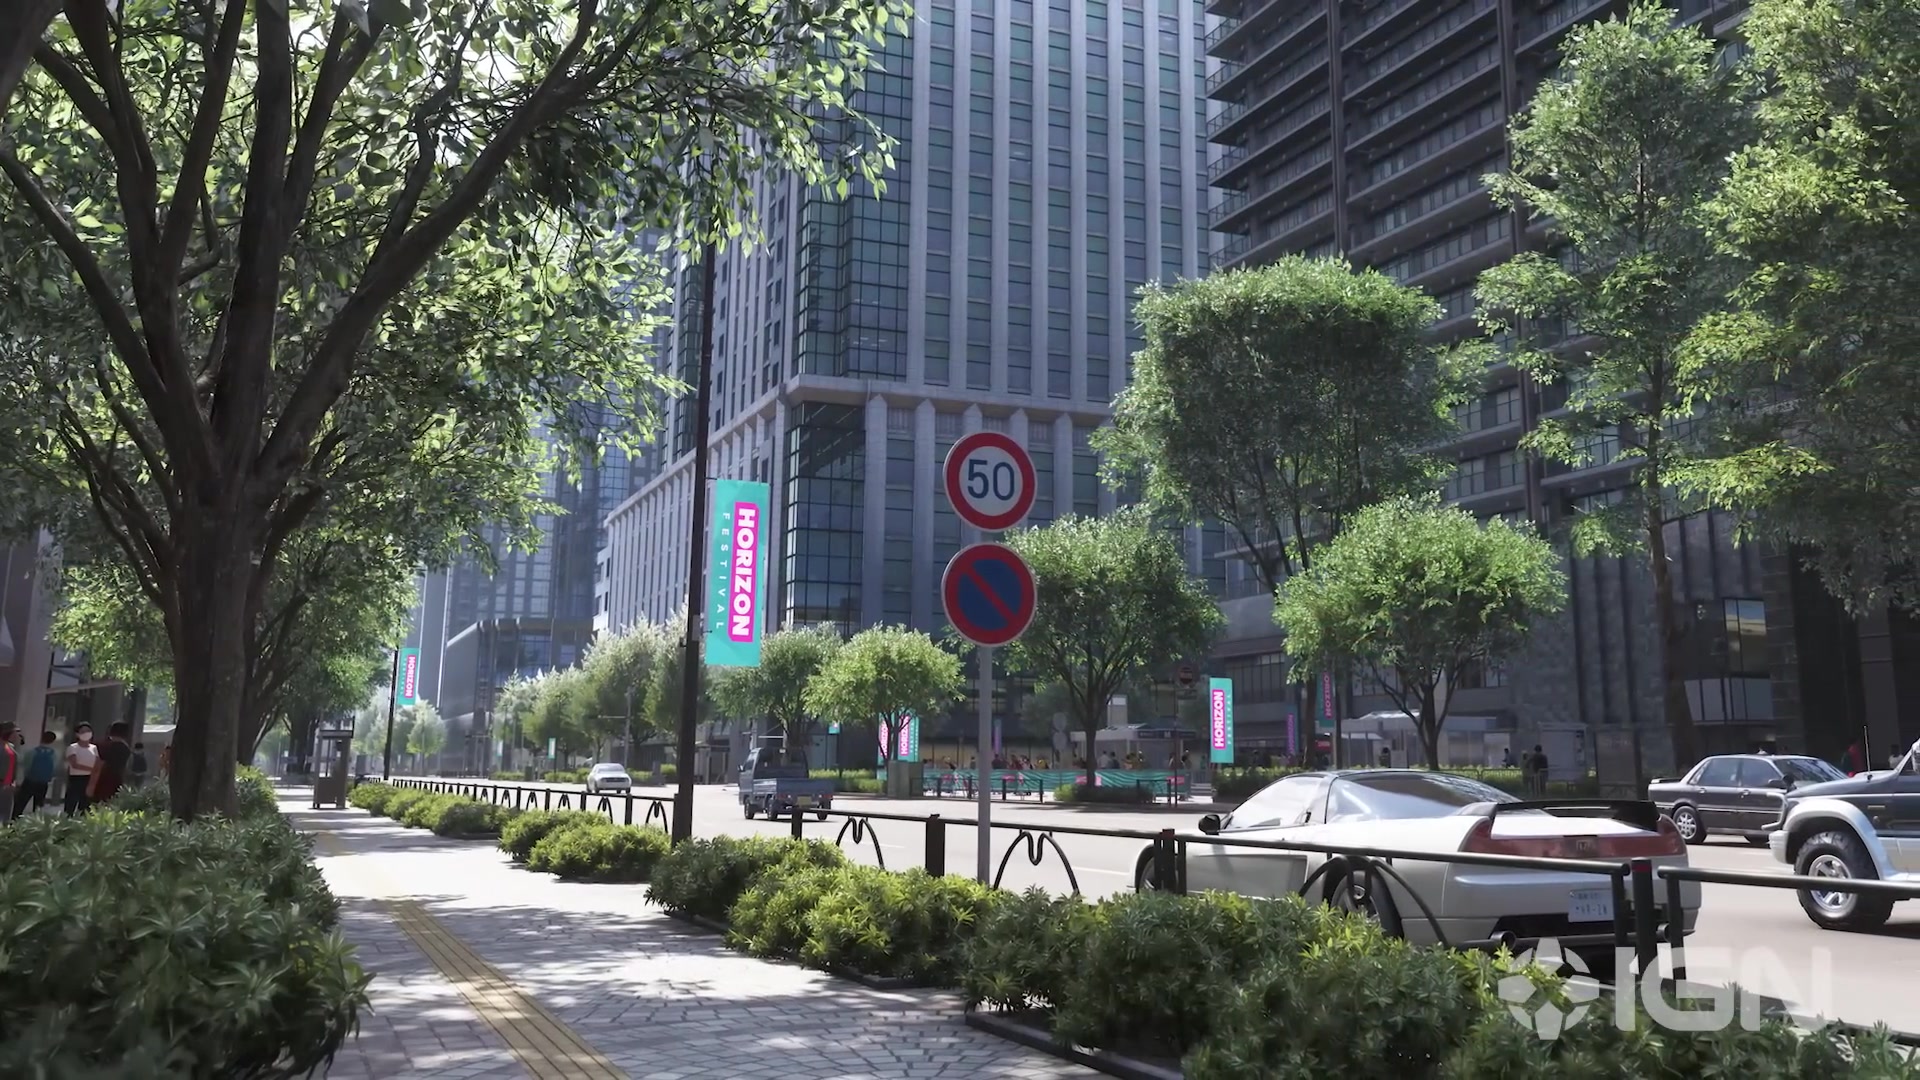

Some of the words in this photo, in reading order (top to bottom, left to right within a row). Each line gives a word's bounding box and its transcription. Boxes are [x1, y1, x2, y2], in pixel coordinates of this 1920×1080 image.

[967, 459, 1015, 501] 50
[716, 512, 730, 629] FESTIVAL
[732, 508, 756, 636] HORIZON
[405, 656, 416, 697] HORIZON
[1213, 691, 1225, 747] HORIZON
